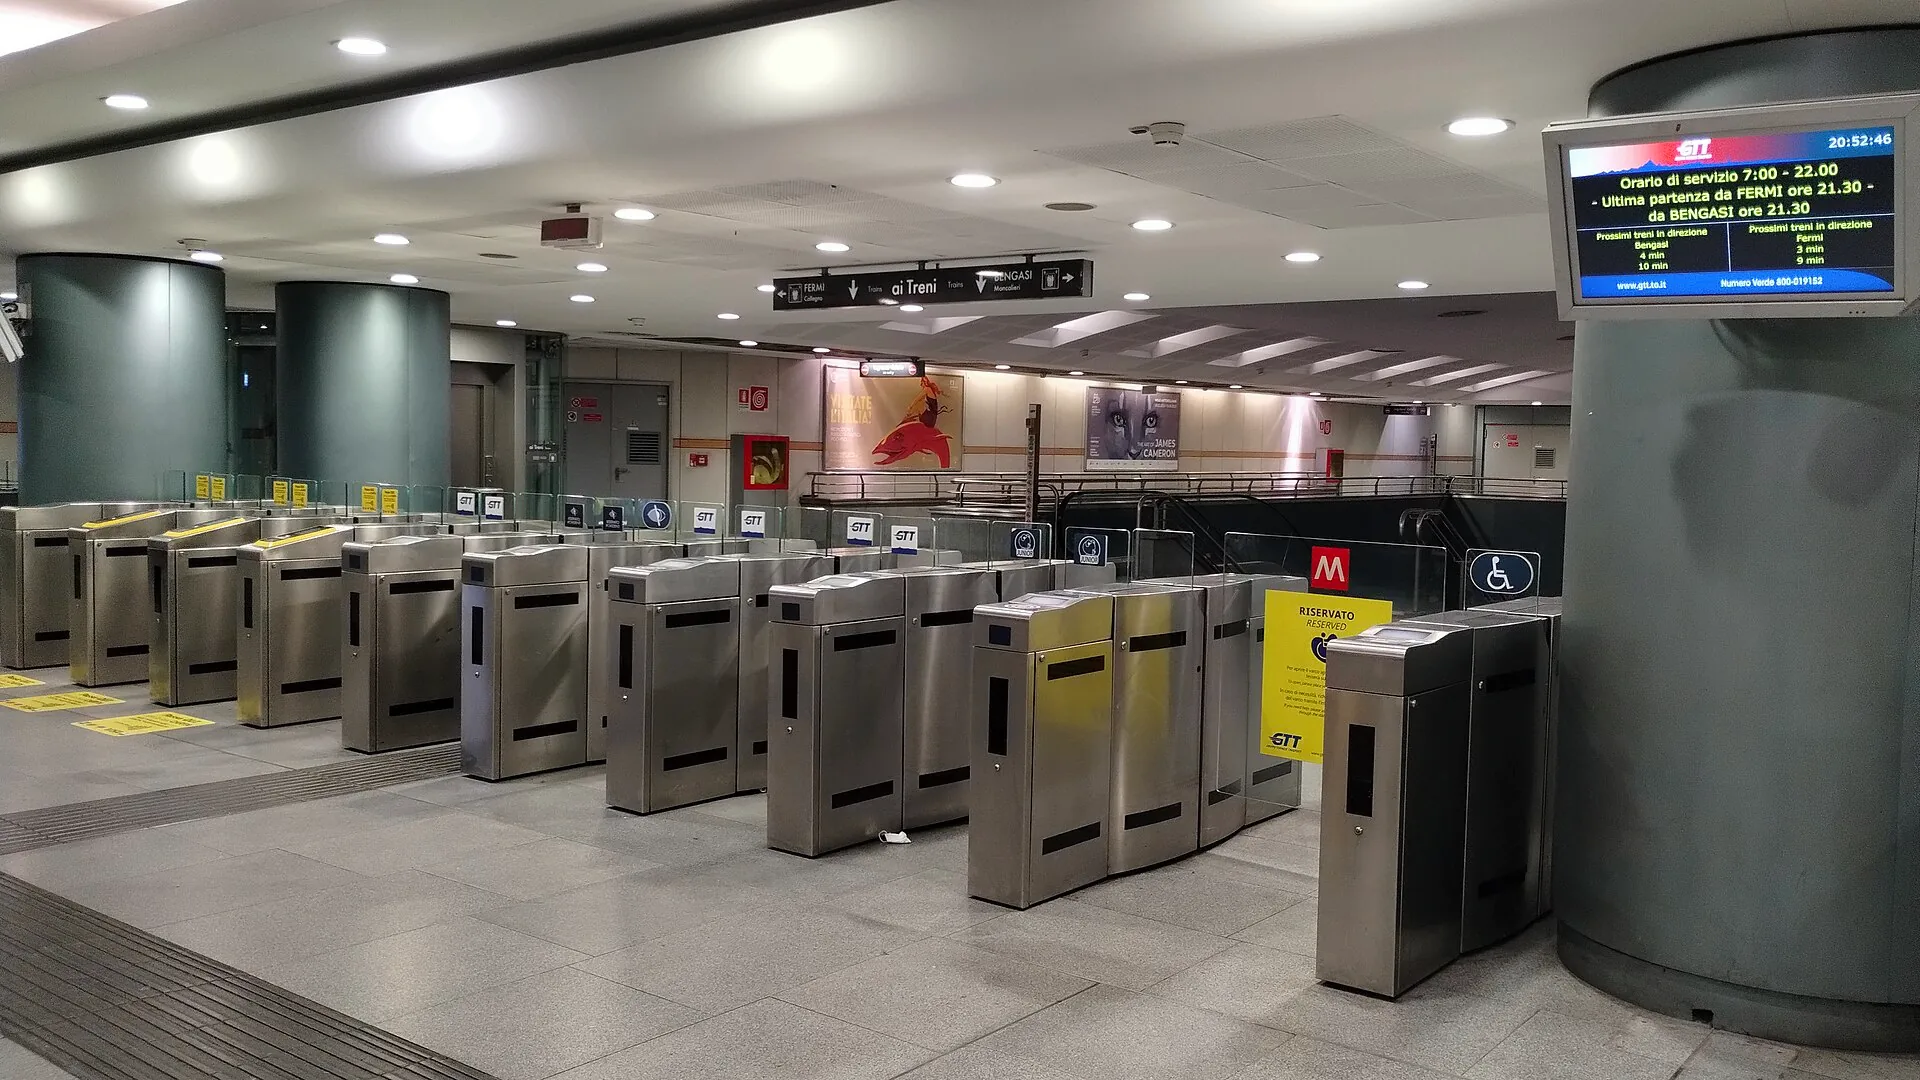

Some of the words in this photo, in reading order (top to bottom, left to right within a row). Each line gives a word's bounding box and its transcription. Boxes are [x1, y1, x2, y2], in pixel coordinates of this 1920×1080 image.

[1828, 133, 1892, 149] 20:52:46
[1677, 138, 1712, 156] GTT
[1620, 175, 1663, 189] Orario
[1667, 173, 1680, 187] di
[1683, 170, 1738, 185] servizio
[1743, 167, 1778, 182] 7:00
[1794, 163, 1839, 179] 22.00
[1602, 193, 1645, 208] Ultima
[1650, 191, 1710, 208] partenza
[1715, 188, 1732, 202] da
[1737, 185, 1782, 200] FERMI
[1788, 184, 1813, 198] ore
[1817, 181, 1862, 195] 21.30
[1648, 208, 1666, 222] da
[1670, 206, 1733, 221] BENGASI
[1739, 204, 1763, 217] ore
[1767, 201, 1810, 216] 21.30
[1749, 223, 1788, 234] Prossimi
[1791, 222, 1813, 231] treni
[1815, 221, 1826, 230] in
[1828, 219, 1873, 230] direzione
[1596, 231, 1632, 241] Prossimi
[1634, 229, 1654, 239] treni
[1656, 229, 1665, 238] in
[1667, 228, 1708, 238] direzione
[1796, 233, 1824, 243] Fermi
[1635, 240, 1669, 250] Bengasi
[1796, 245, 1803, 254] 3
[1805, 245, 1824, 254] min
[1639, 251, 1646, 260] 4
[1648, 251, 1665, 260] min
[1796, 256, 1804, 265] 9
[1805, 255, 1825, 265] min
[1638, 262, 1650, 271] 10
[1651, 261, 1669, 271] min
[804, 282, 825, 293] FERMI
[868, 285, 883, 294] Trains
[891, 280, 904, 296] ai
[906, 278, 937, 296] Treni
[947, 281, 964, 289] Trains
[993, 283, 1021, 292] Moncalieri
[1617, 280, 1667, 291] www.gtt.to.it
[1720, 278, 1751, 288] Numero
[1752, 278, 1775, 288] Verde
[1776, 276, 1823, 286] 800-019152
[1155, 438, 1176, 448] JAMES
[1143, 448, 1176, 458] CAMERON
[1016, 549, 1034, 557] JUNIOR
[1080, 556, 1099, 564] JUNIOR
[1313, 555, 1346, 583] M
[1299, 606, 1355, 621] RISERVATO
[1306, 618, 1347, 631] RESERVED
[1269, 732, 1302, 749] GTT
